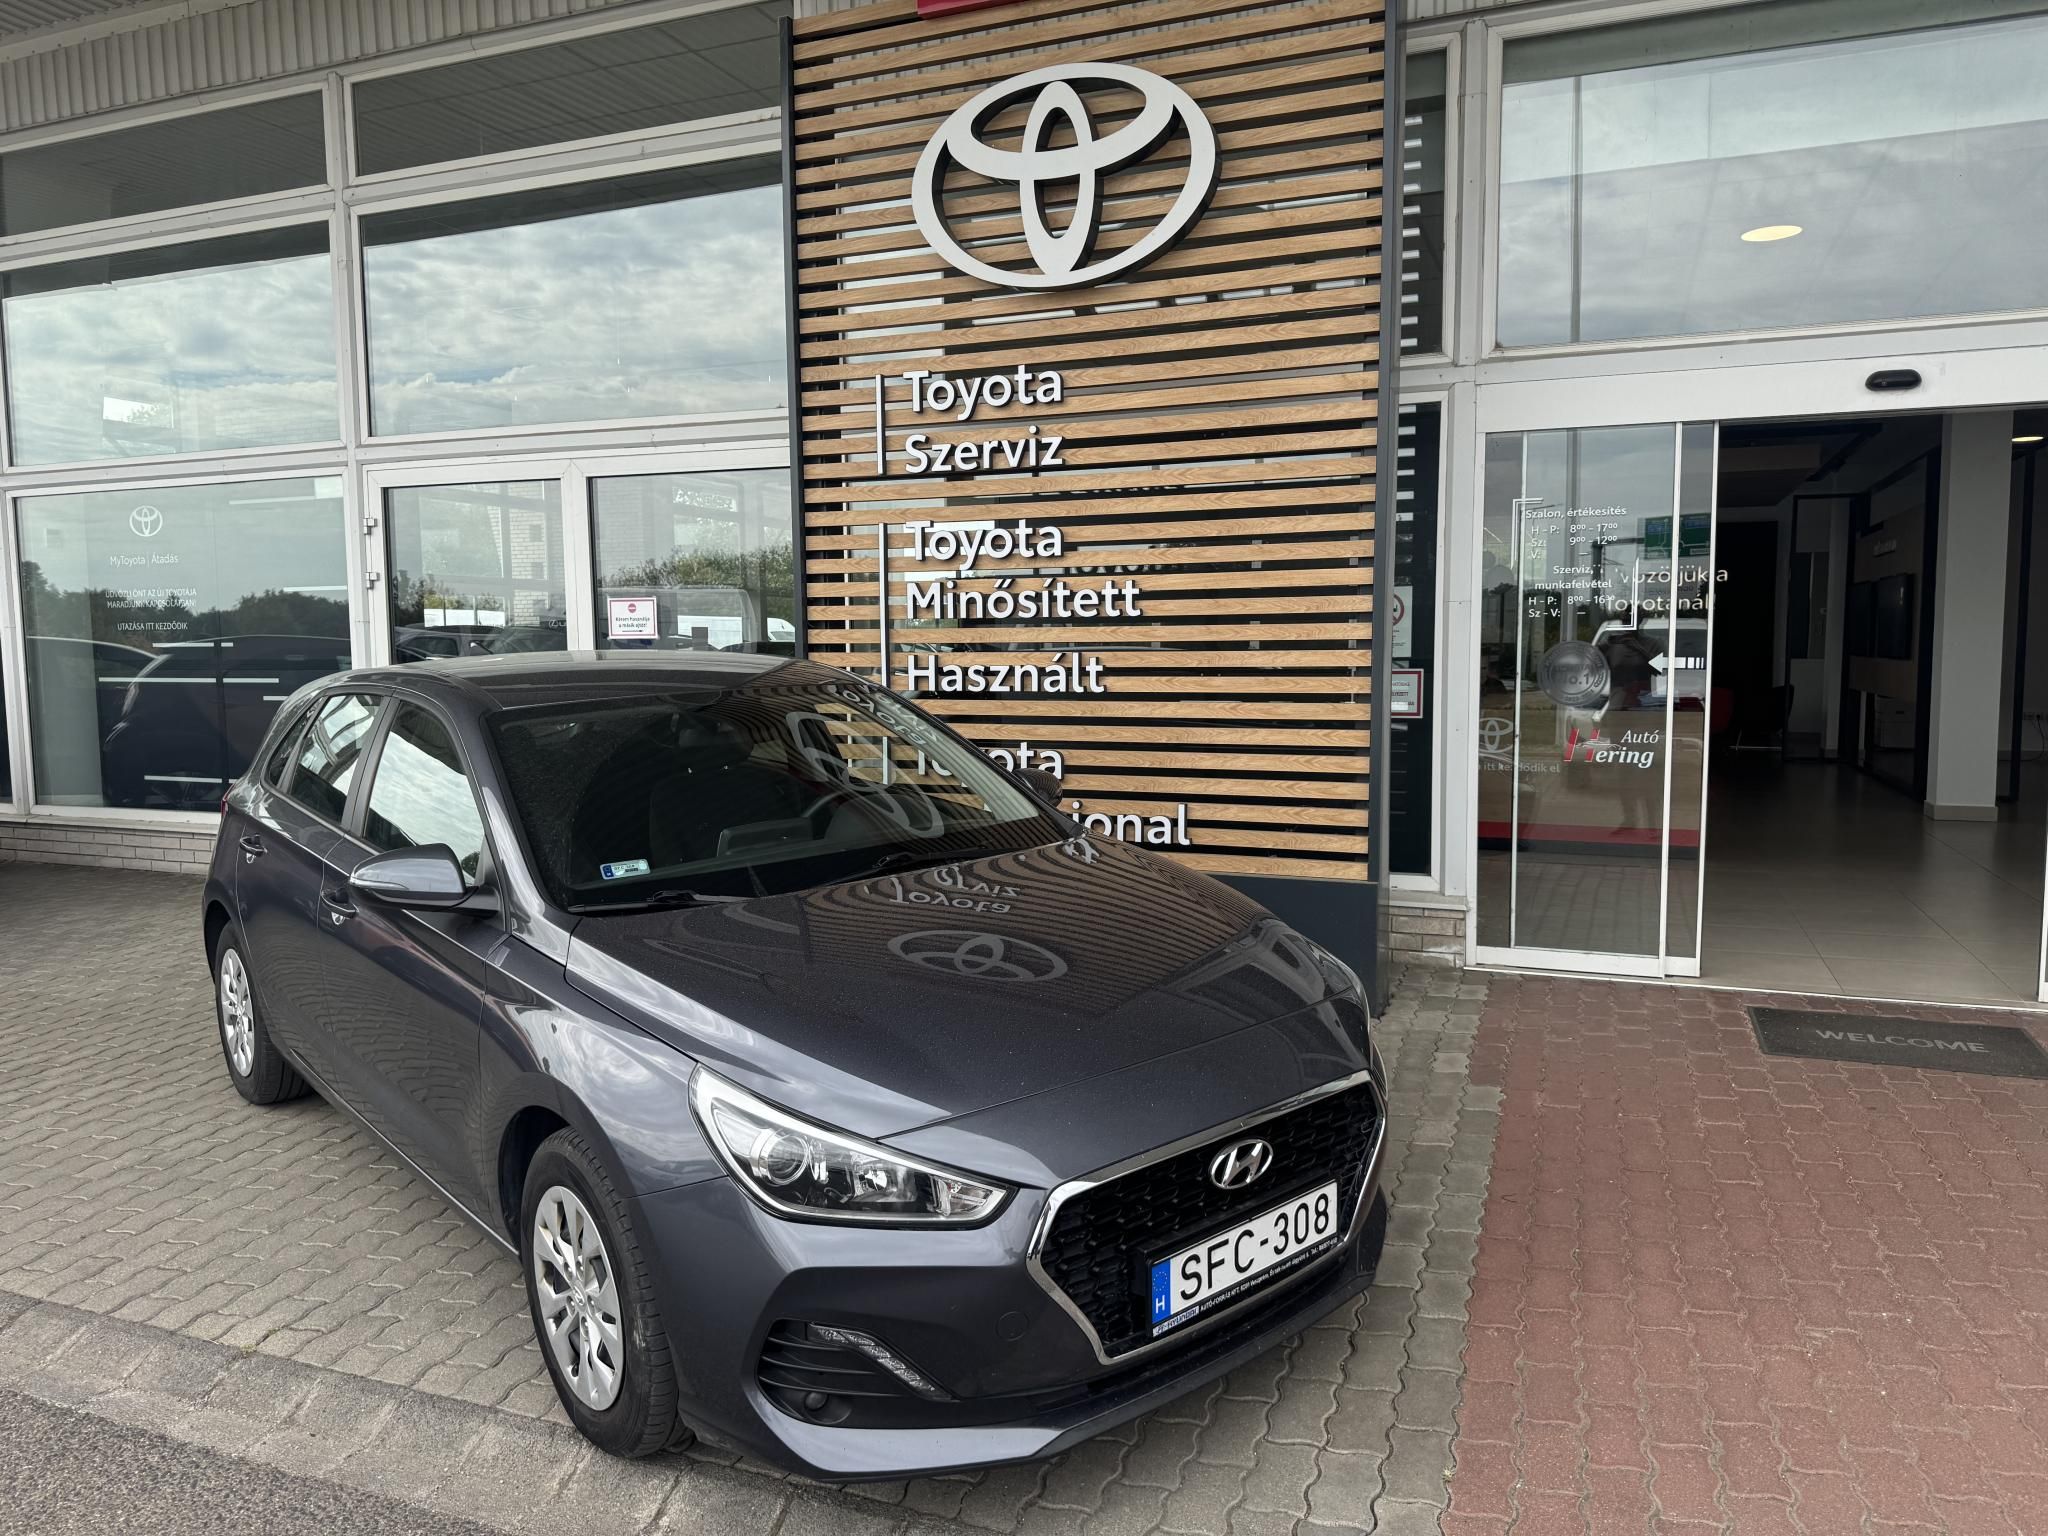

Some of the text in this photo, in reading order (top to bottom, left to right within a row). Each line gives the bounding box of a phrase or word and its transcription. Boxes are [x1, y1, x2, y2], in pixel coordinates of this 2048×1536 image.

[903, 364, 1063, 421] Toyota
[905, 425, 1064, 473] Szerviz
[1525, 507, 1627, 519] Szalon, értékesítés
[905, 519, 1064, 570] Toyota
[110, 555, 146, 568] MyToyota
[1553, 565, 1594, 575] Szerviz,
[1535, 579, 1612, 590] munkafelvétel
[906, 578, 1142, 619] Minősített
[907, 651, 1105, 693] Használt
[1621, 729, 1659, 744] Autó
[1816, 1029, 1991, 1053] WELCOME
[1180, 1192, 1330, 1301] SFC-308
[1155, 1295, 1166, 1315] H
